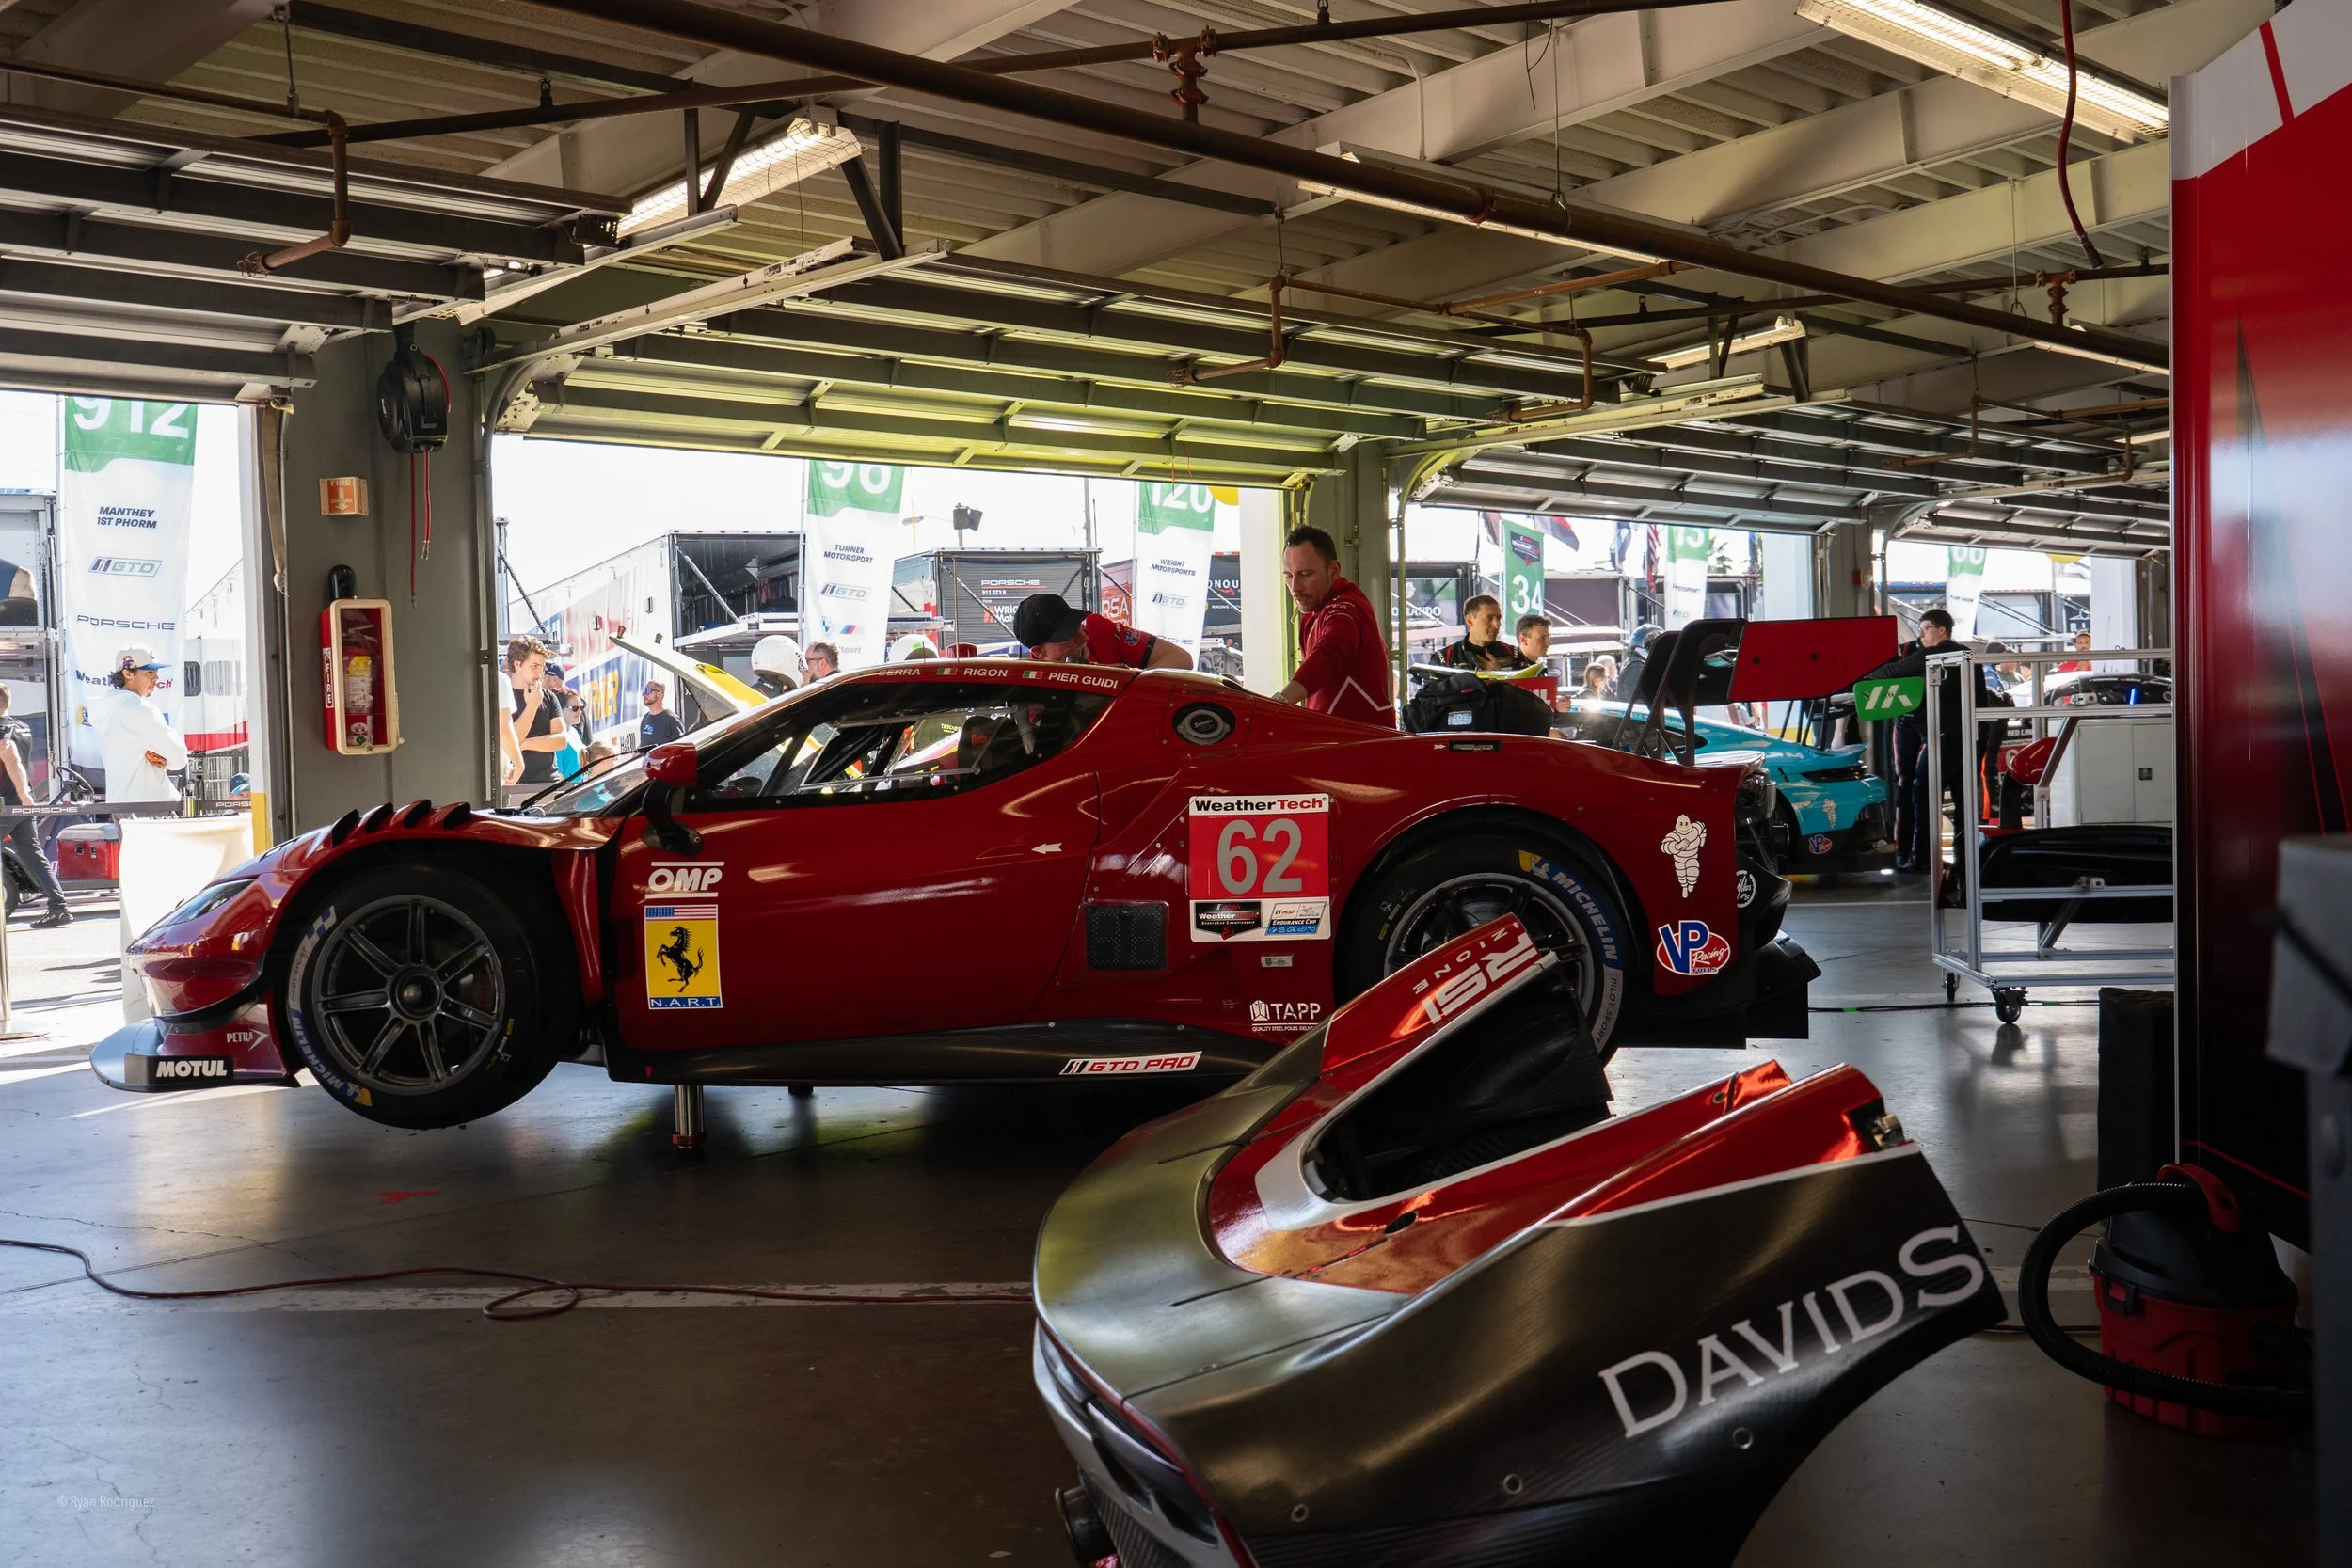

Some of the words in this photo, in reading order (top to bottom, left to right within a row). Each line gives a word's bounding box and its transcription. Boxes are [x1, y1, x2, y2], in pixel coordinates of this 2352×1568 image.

[821, 460, 892, 495] 96
[99, 506, 155, 517] MANTHEY
[97, 516, 114, 526] 1ST
[115, 517, 157, 530] PHORM
[823, 551, 874, 563] MOTORSPORT
[834, 544, 865, 554] TURNER
[111, 561, 155, 574] GTD
[1160, 558, 1185, 567] WRIGHT
[834, 586, 867, 598] GTD
[1511, 574, 1545, 617] 34
[1161, 596, 1185, 607] GTD
[1391, 606, 1442, 617] OLANDO
[77, 614, 176, 630] PORSCHE
[879, 668, 921, 676] SERRA
[963, 668, 1009, 677] RIGON
[1048, 672, 1079, 683] PIER
[1082, 675, 1119, 689] GUIDI
[325, 663, 334, 704] FIRE
[1195, 797, 1324, 812] WeatherTech
[1216, 817, 1303, 895] 62
[647, 867, 723, 892] OMP
[1551, 871, 1619, 961] MICHELIN
[1658, 920, 1710, 974] VP
[1692, 947, 1729, 967] Racing
[1609, 977, 1618, 1009] PILOT
[650, 997, 721, 1007] N.A.R.T.
[1270, 1002, 1321, 1020] TAPP
[1596, 1009, 1613, 1044] SPORT
[227, 1031, 253, 1043] PETRA
[292, 1016, 345, 1090] MICHELIN
[156, 1060, 228, 1078] MOTUL
[1088, 1060, 1140, 1072] GTD
[1142, 1054, 1196, 1070] PRO
[1598, 1224, 1985, 1440] DAVIDS
